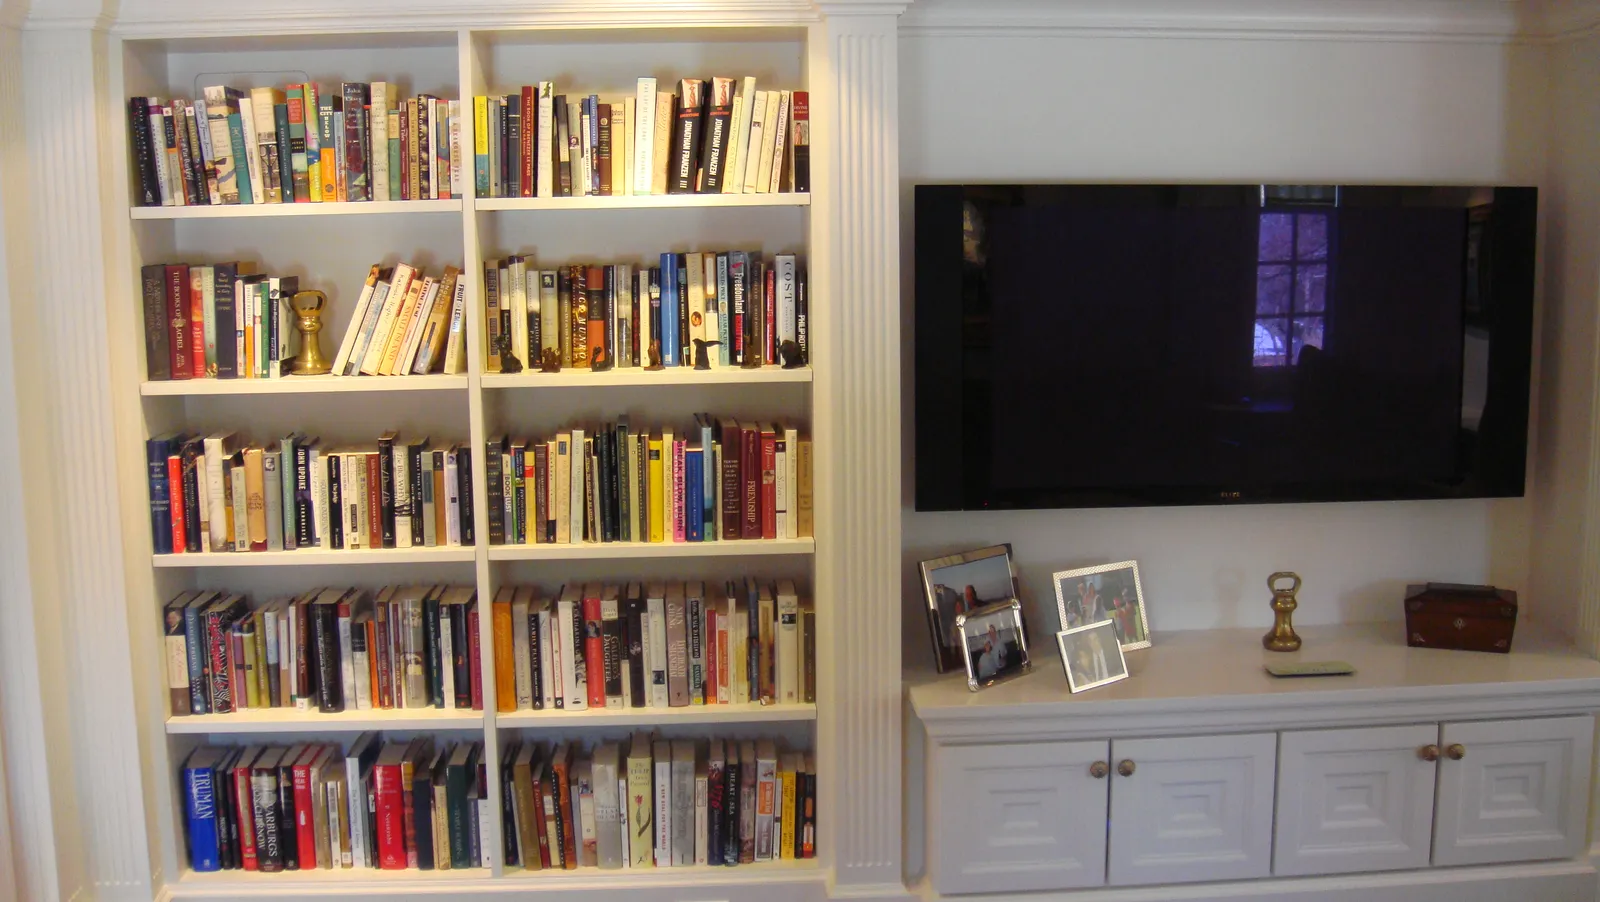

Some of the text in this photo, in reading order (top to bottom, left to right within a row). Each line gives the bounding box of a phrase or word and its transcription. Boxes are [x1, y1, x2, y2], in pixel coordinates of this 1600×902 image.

[680, 121, 692, 178] JONATHAN FRANZEN
[709, 119, 723, 176] JONATHAN FRANZEN
[734, 273, 745, 314] Freedomland
[784, 262, 792, 303] COST
[174, 309, 181, 318] OF
[452, 284, 464, 332] FRUIT LEMON
[388, 306, 410, 361] SMALL ISLAND
[578, 317, 586, 359] MUNRO
[298, 466, 306, 490] UPDIKE
[747, 480, 755, 523] FRIENDSHIP
[604, 634, 612, 682] DAUGHTER
[612, 636, 620, 680] GALILEO'S
[194, 772, 214, 819] TRUMAN
[711, 785, 724, 811] 1776
[254, 803, 265, 851] CHERNOW
